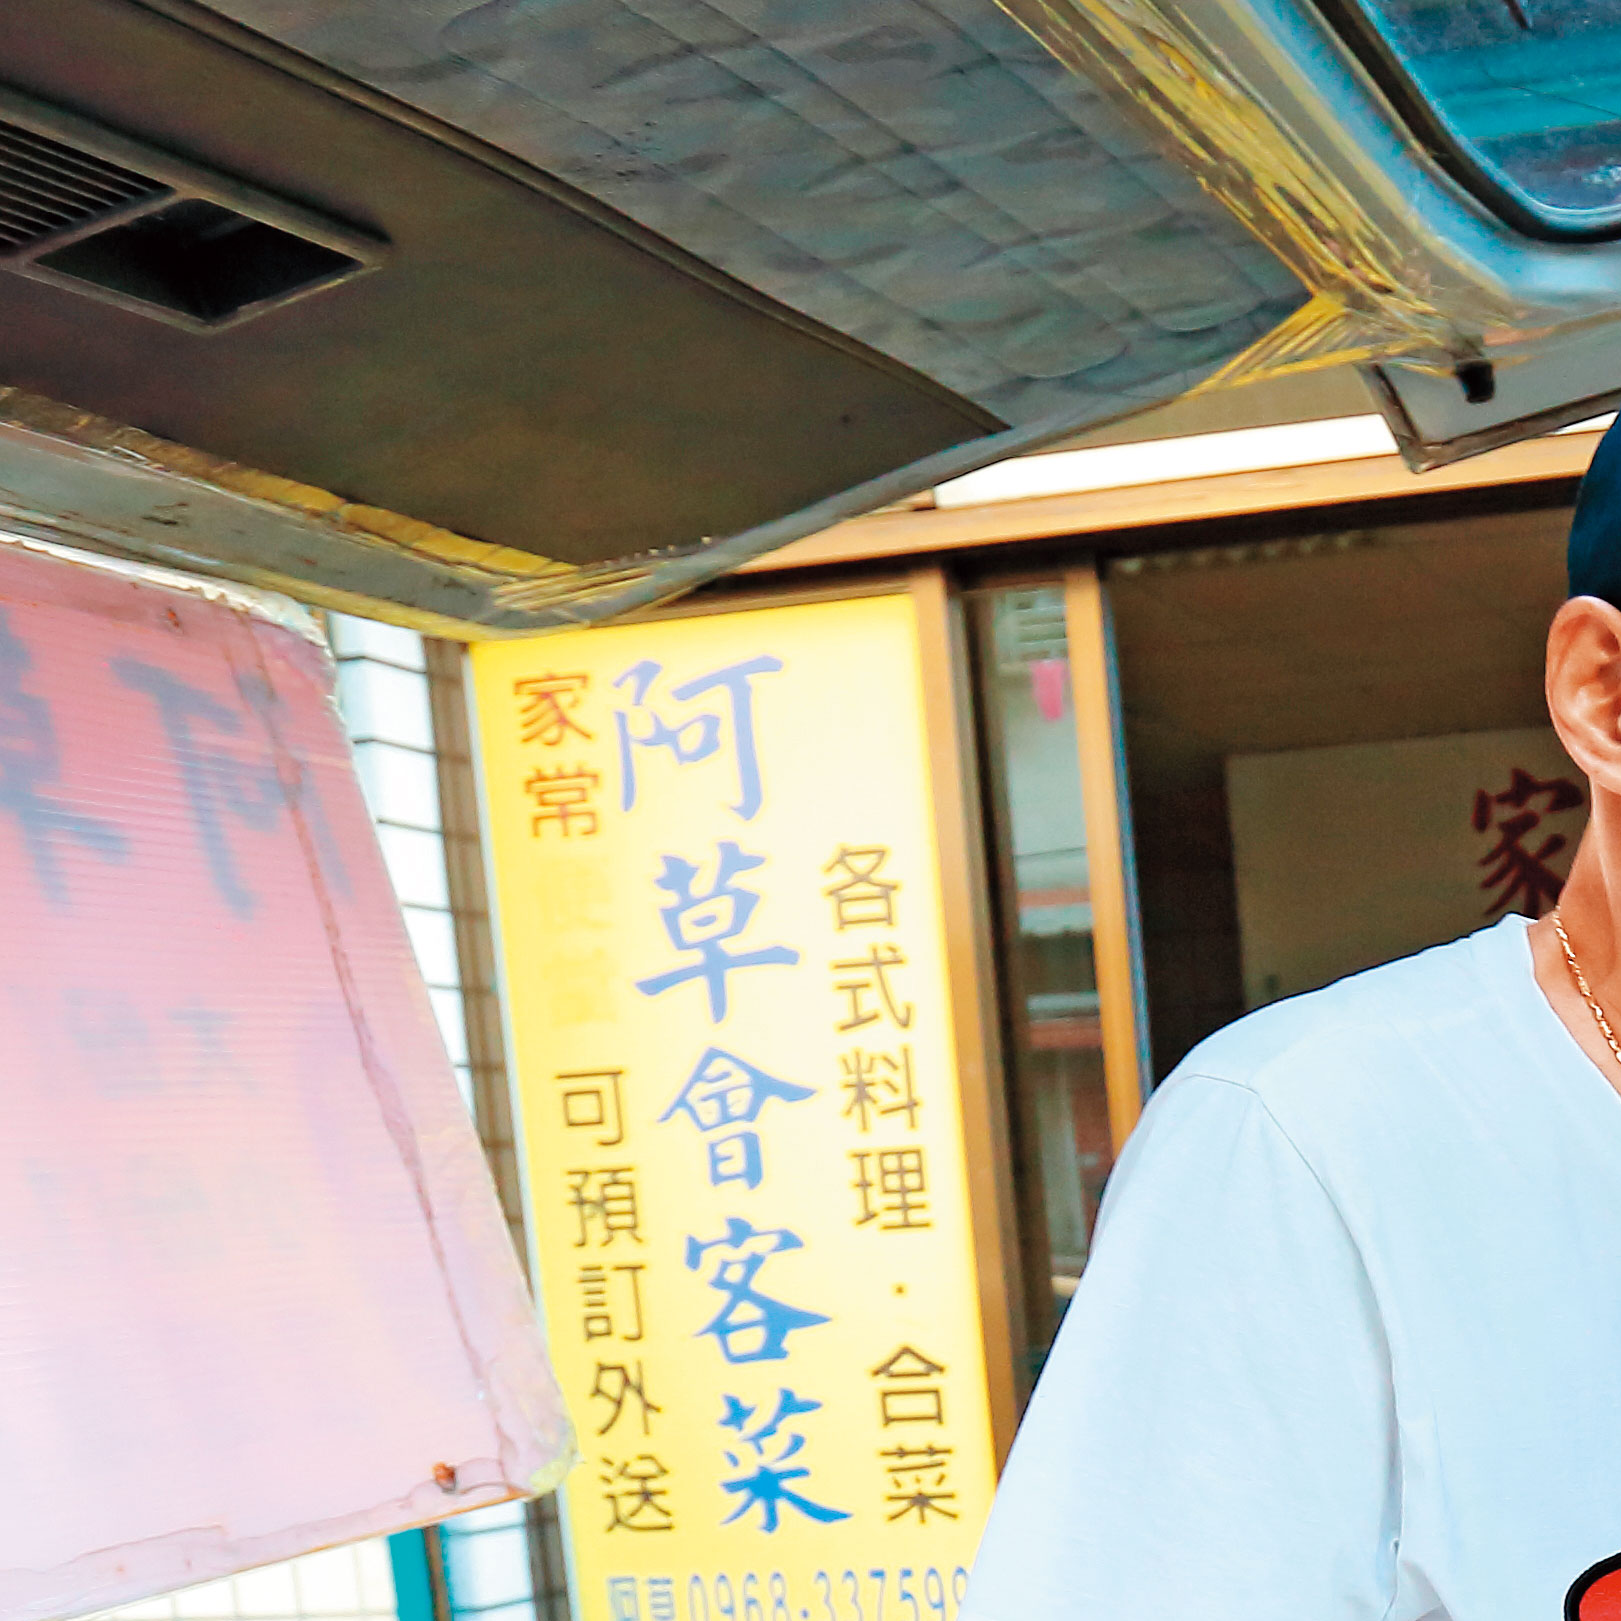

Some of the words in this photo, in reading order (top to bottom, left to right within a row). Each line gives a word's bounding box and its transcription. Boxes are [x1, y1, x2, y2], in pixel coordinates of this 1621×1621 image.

[555, 1067, 676, 1533] 可預訂外送
[612, 655, 854, 1534] 阿草會客菜
